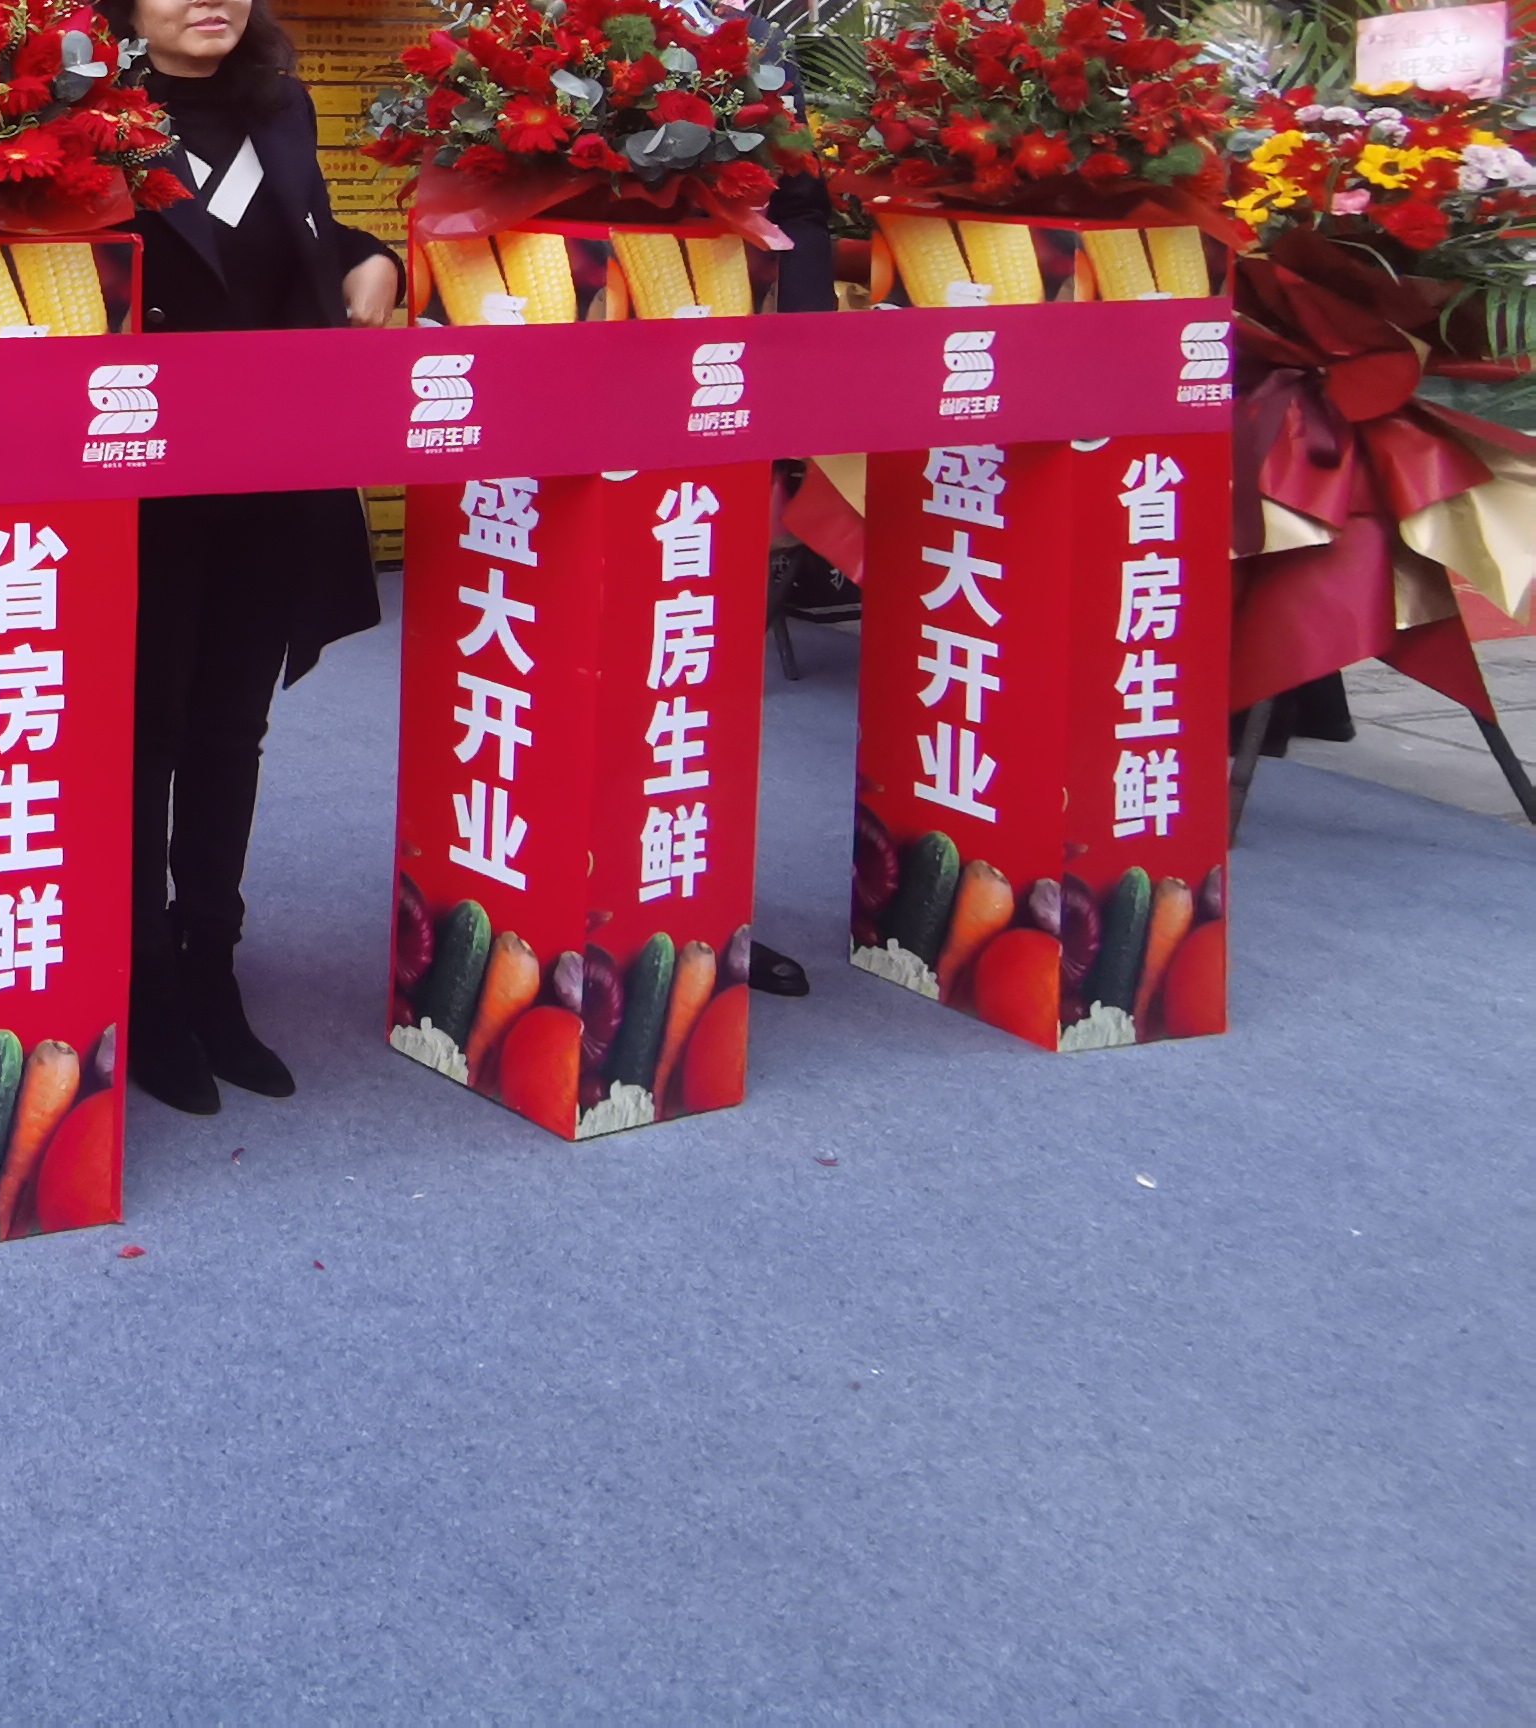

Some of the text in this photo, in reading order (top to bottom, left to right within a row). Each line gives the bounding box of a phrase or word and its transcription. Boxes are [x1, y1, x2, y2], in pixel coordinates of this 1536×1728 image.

[83, 439, 167, 462] 省房生鲜
[407, 426, 482, 450] 省房生鲜
[688, 410, 750, 432] 省房生鲜
[939, 395, 1000, 417] 省房生鲜
[449, 477, 539, 890] 盛大开业
[639, 482, 719, 902] 省房生鲜
[914, 446, 1005, 823] 盛大开业
[1113, 453, 1183, 837] 省房生鲜
